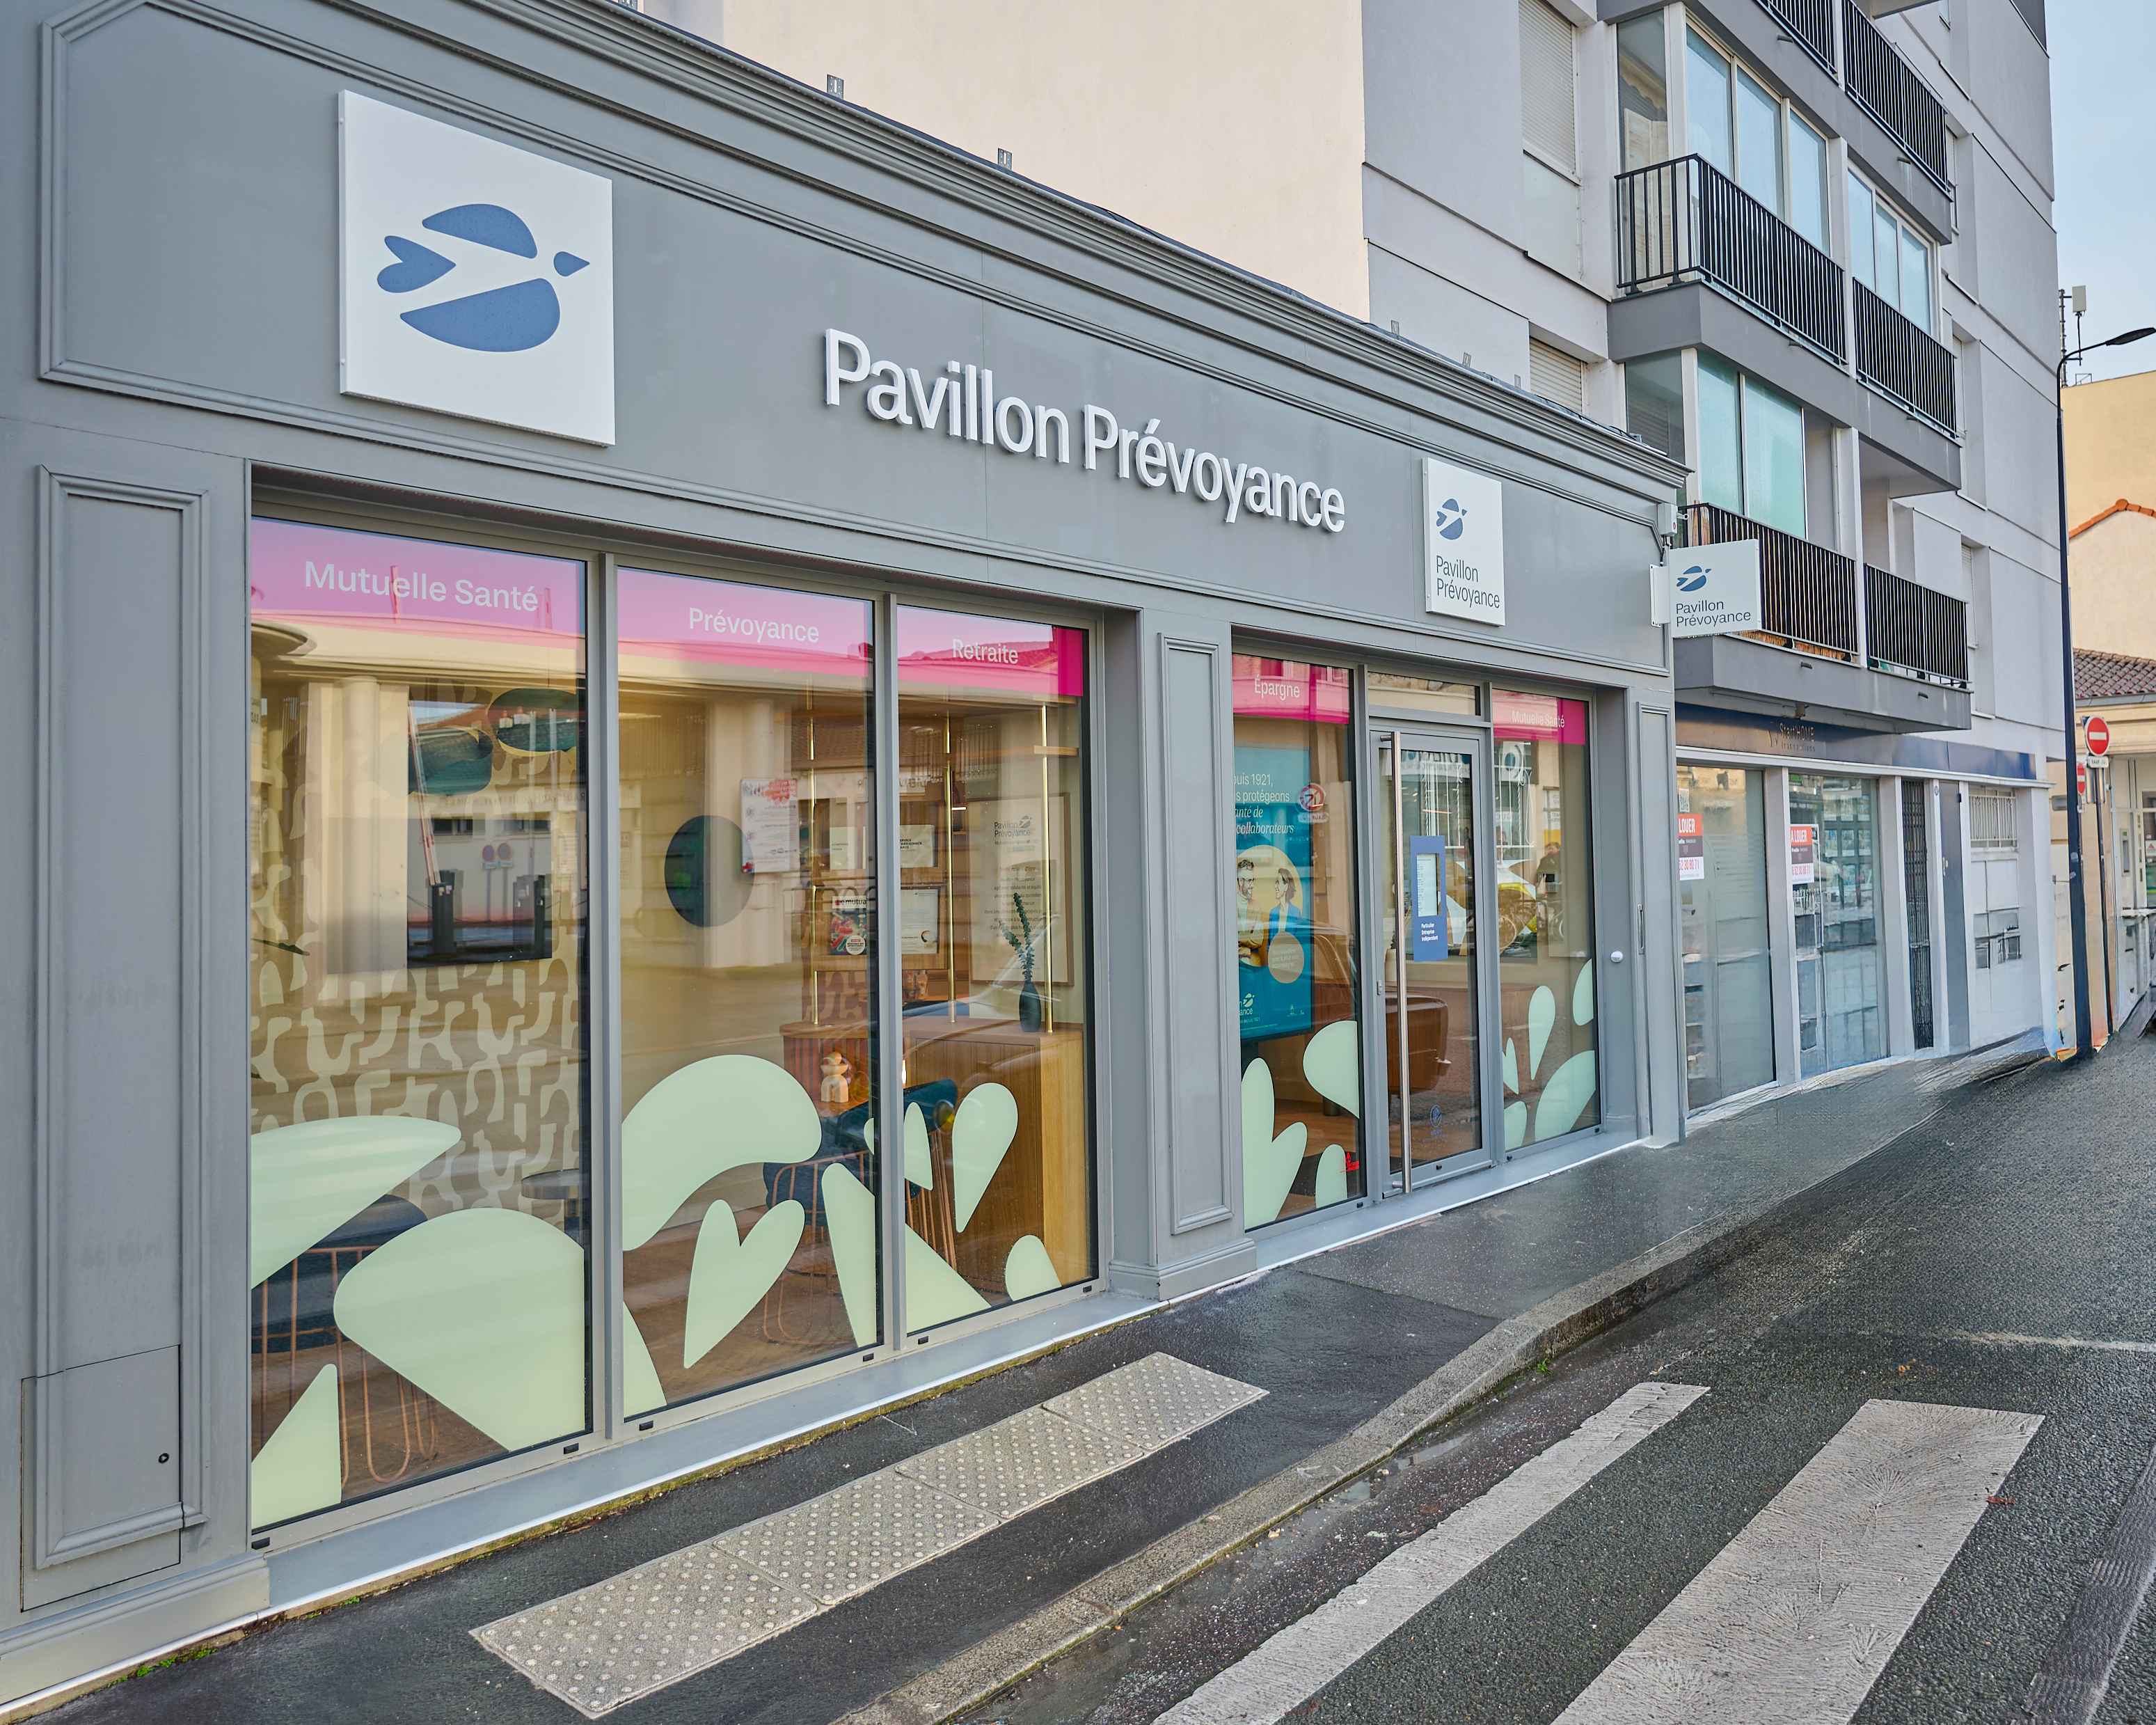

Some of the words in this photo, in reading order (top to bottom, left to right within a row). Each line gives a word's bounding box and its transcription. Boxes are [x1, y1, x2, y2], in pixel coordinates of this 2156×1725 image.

[825, 329, 1070, 464] Pavillon
[1084, 404, 1345, 533] Prévoyance
[1436, 555, 1478, 583] Pavillon
[305, 560, 447, 602] Mutuelle
[454, 579, 539, 612] Santé
[1437, 578, 1500, 608] Prévoyance
[1677, 599, 1725, 614] Pavillon
[690, 607, 819, 643] Prévoyance
[1677, 612, 1751, 627] Prévoyance
[953, 638, 1019, 664] Retraite
[1254, 674, 1300, 701] Épargne
[1511, 710, 1543, 725] Mutuelle
[1544, 714, 1565, 728] Santé
[1252, 773, 1274, 787] 1921,
[1243, 789, 1290, 805] protégeons
[1253, 806, 1264, 818] de
[1236, 821, 1294, 835] collaborateurs
[1679, 818, 1696, 833] LOUER
[1795, 829, 1807, 843] LOUER
